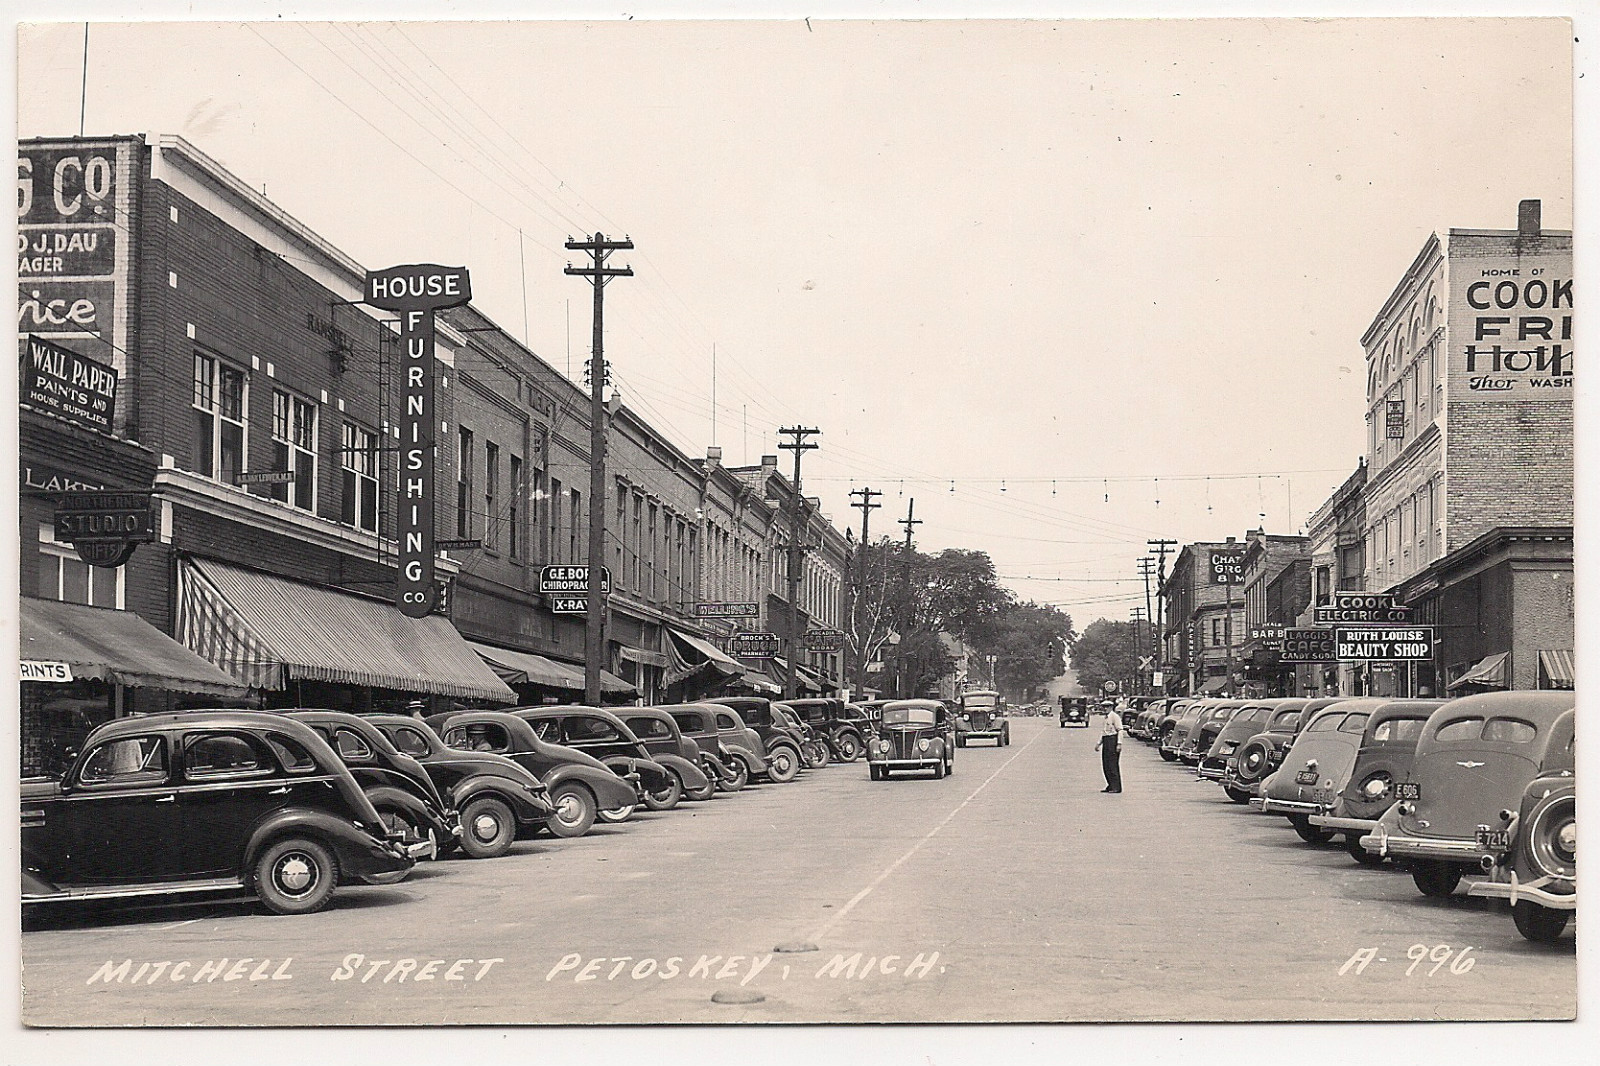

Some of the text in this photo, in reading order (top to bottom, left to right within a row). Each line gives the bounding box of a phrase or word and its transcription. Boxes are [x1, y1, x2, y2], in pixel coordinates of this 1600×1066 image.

[18, 257, 63, 272] AGER
[372, 274, 461, 298] HOUSE
[31, 342, 115, 398] WALL PAPER
[1469, 375, 1573, 391] Thor WASH
[36, 375, 107, 412] PAINTS AND
[30, 390, 108, 425] HOUSE SUPPLIES
[404, 311, 424, 582] FURNISHING
[61, 515, 139, 532] STUDIO
[542, 580, 607, 590] CHIROPRACR
[403, 592, 427, 604] CO.
[1340, 597, 1389, 609] COOK
[1318, 610, 1406, 621] ELECTRIC CO
[1252, 629, 1274, 639] BAR
[1346, 630, 1424, 641] RUTH LOUISE
[1287, 640, 1331, 652] CAFE
[1338, 643, 1429, 657] BEAUTY SHOP
[1281, 652, 1310, 660] CANDY
[1396, 785, 1402, 795] E
[1485, 832, 1509, 846] 7214
